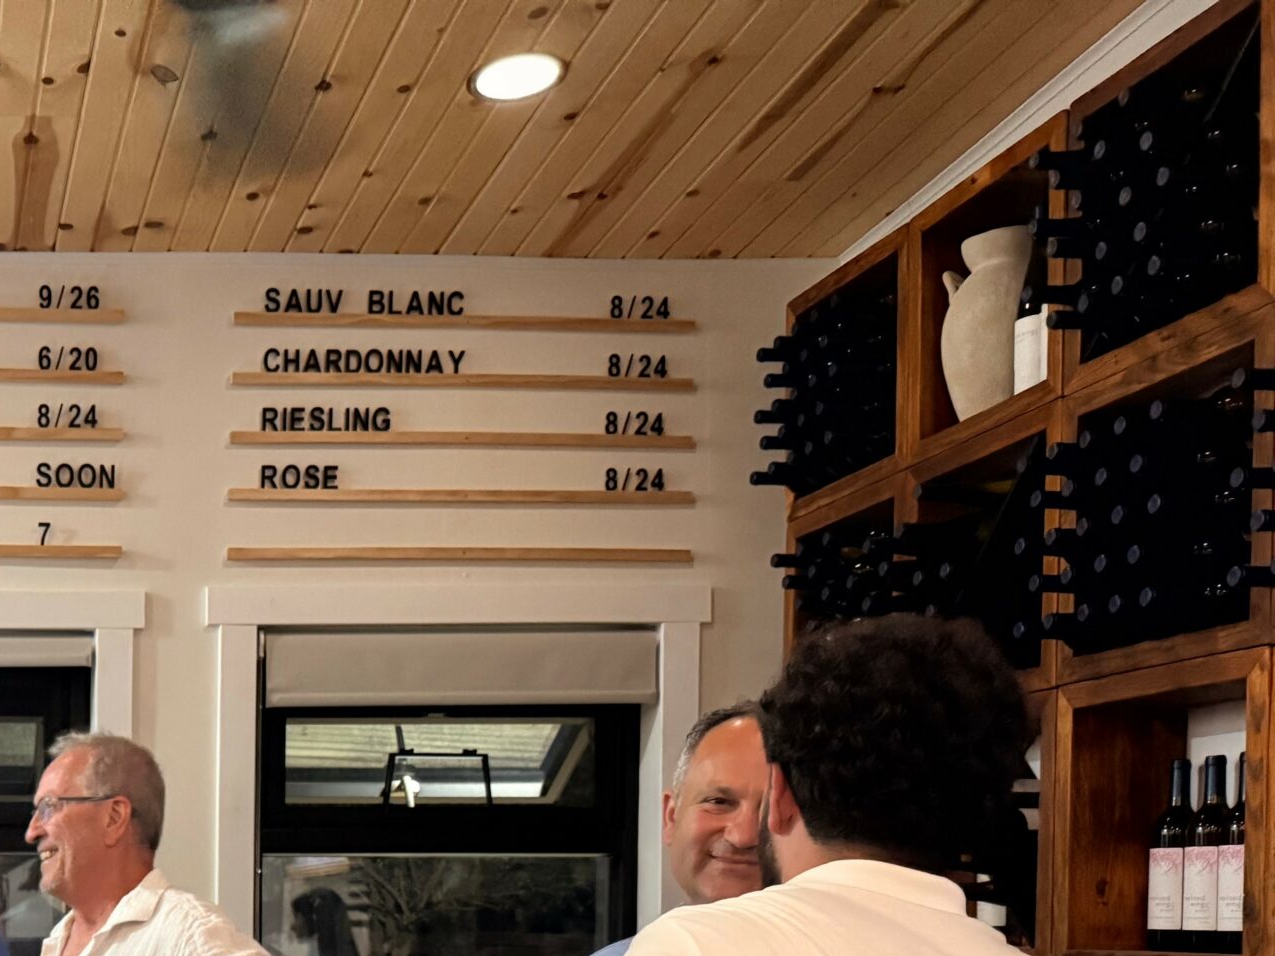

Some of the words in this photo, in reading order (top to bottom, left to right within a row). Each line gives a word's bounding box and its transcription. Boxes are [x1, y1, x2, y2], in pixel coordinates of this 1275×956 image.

[38, 285, 100, 310] 9/26
[264, 287, 344, 314] SAUV
[367, 290, 465, 316] BLANC
[609, 296, 671, 319] 8/24
[37, 346, 98, 371] 6/20
[263, 348, 466, 374] CHARDONNAY
[608, 354, 669, 378] 8/24
[37, 404, 98, 429] 8/24
[261, 407, 392, 431] RIESLING
[604, 411, 665, 436] 8/24
[35, 463, 116, 489] SOON
[260, 465, 339, 490] ROSE
[604, 468, 665, 492] 8/24
[38, 522, 51, 546] 7
